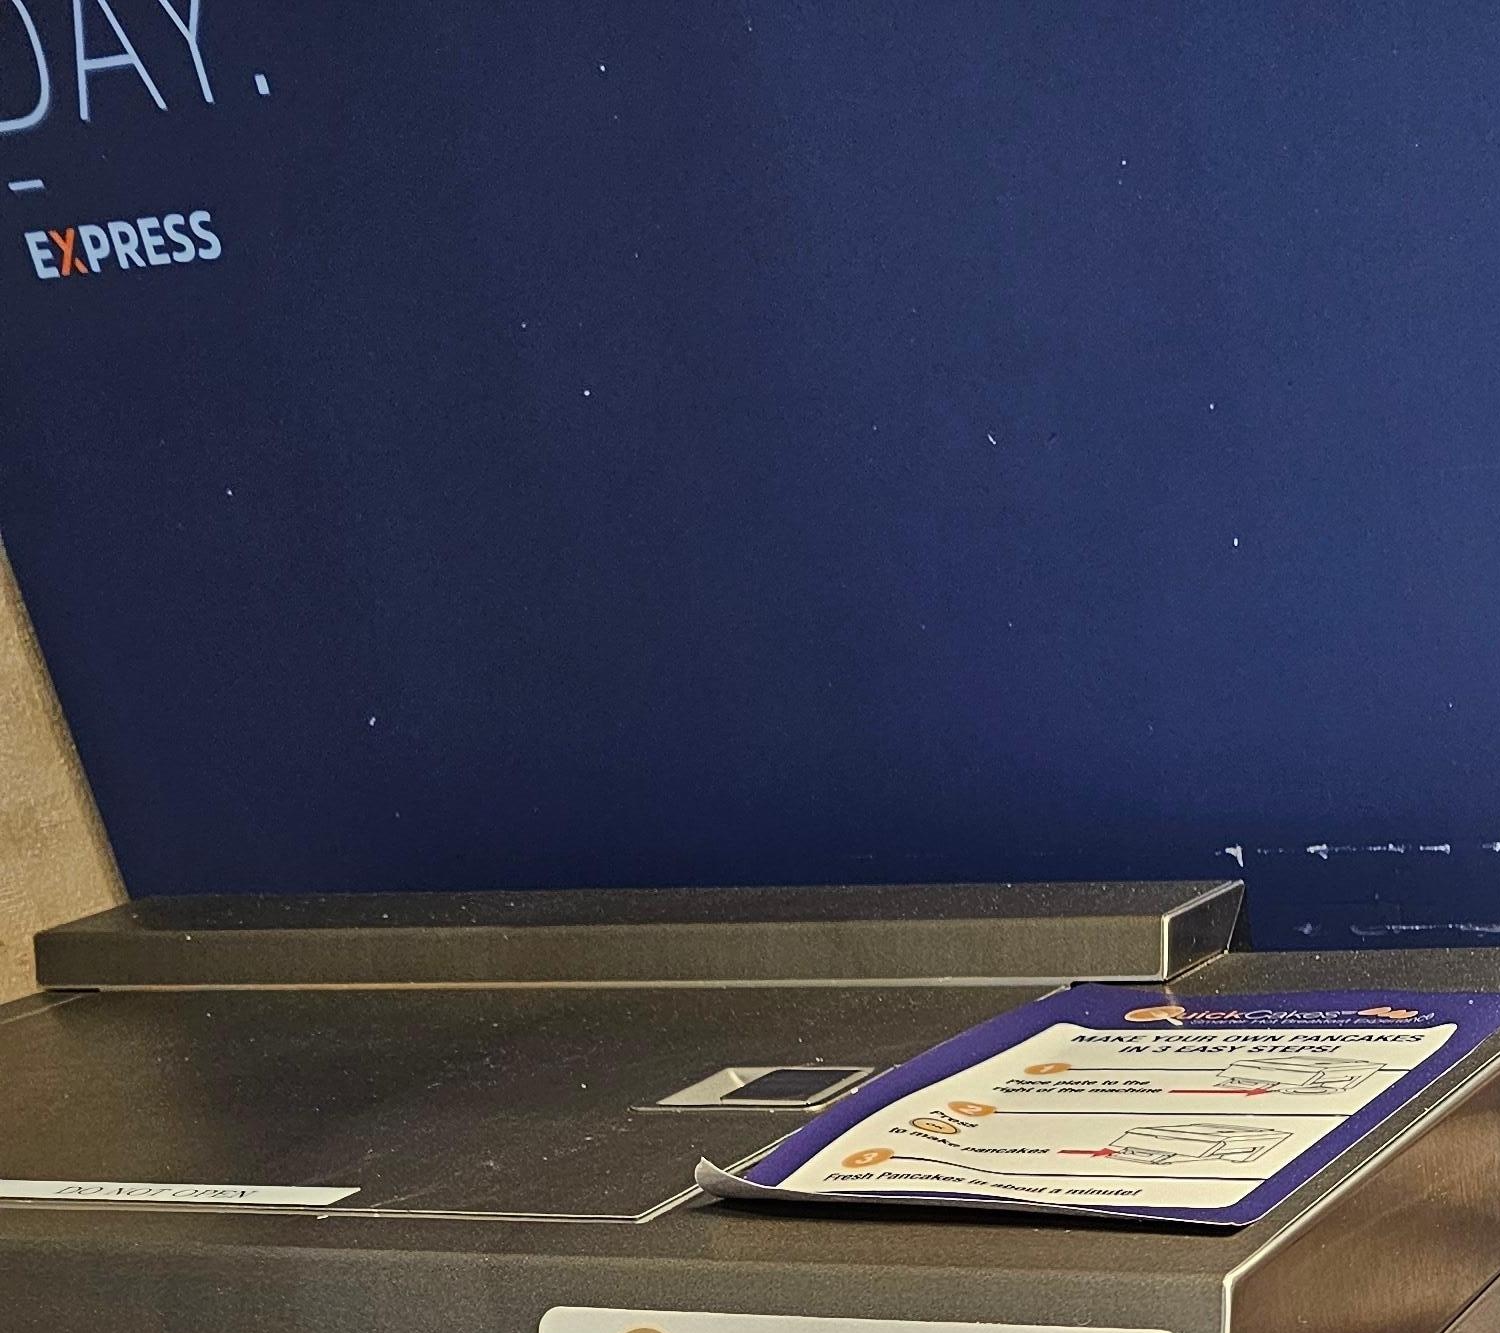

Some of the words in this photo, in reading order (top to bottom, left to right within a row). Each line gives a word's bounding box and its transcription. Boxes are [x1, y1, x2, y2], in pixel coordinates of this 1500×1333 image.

[24, 209, 222, 280] EXPRESS
[1071, 1035, 1147, 1043] MAKE
[1152, 1035, 1218, 1043] YOUR
[1223, 1035, 1285, 1043] OWN
[1289, 1034, 1425, 1042] PANCAKES
[1117, 1045, 1151, 1053] IN
[1152, 1045, 1172, 1053] 3
[1174, 1045, 1246, 1053] EASY
[888, 1126, 907, 1134] to
[823, 1172, 875, 1182] Fresh
[879, 1171, 964, 1183] Pancakes
[56, 1185, 104, 1195] DO
[107, 1187, 173, 1197] NOT
[172, 1188, 260, 1199] OPEN
